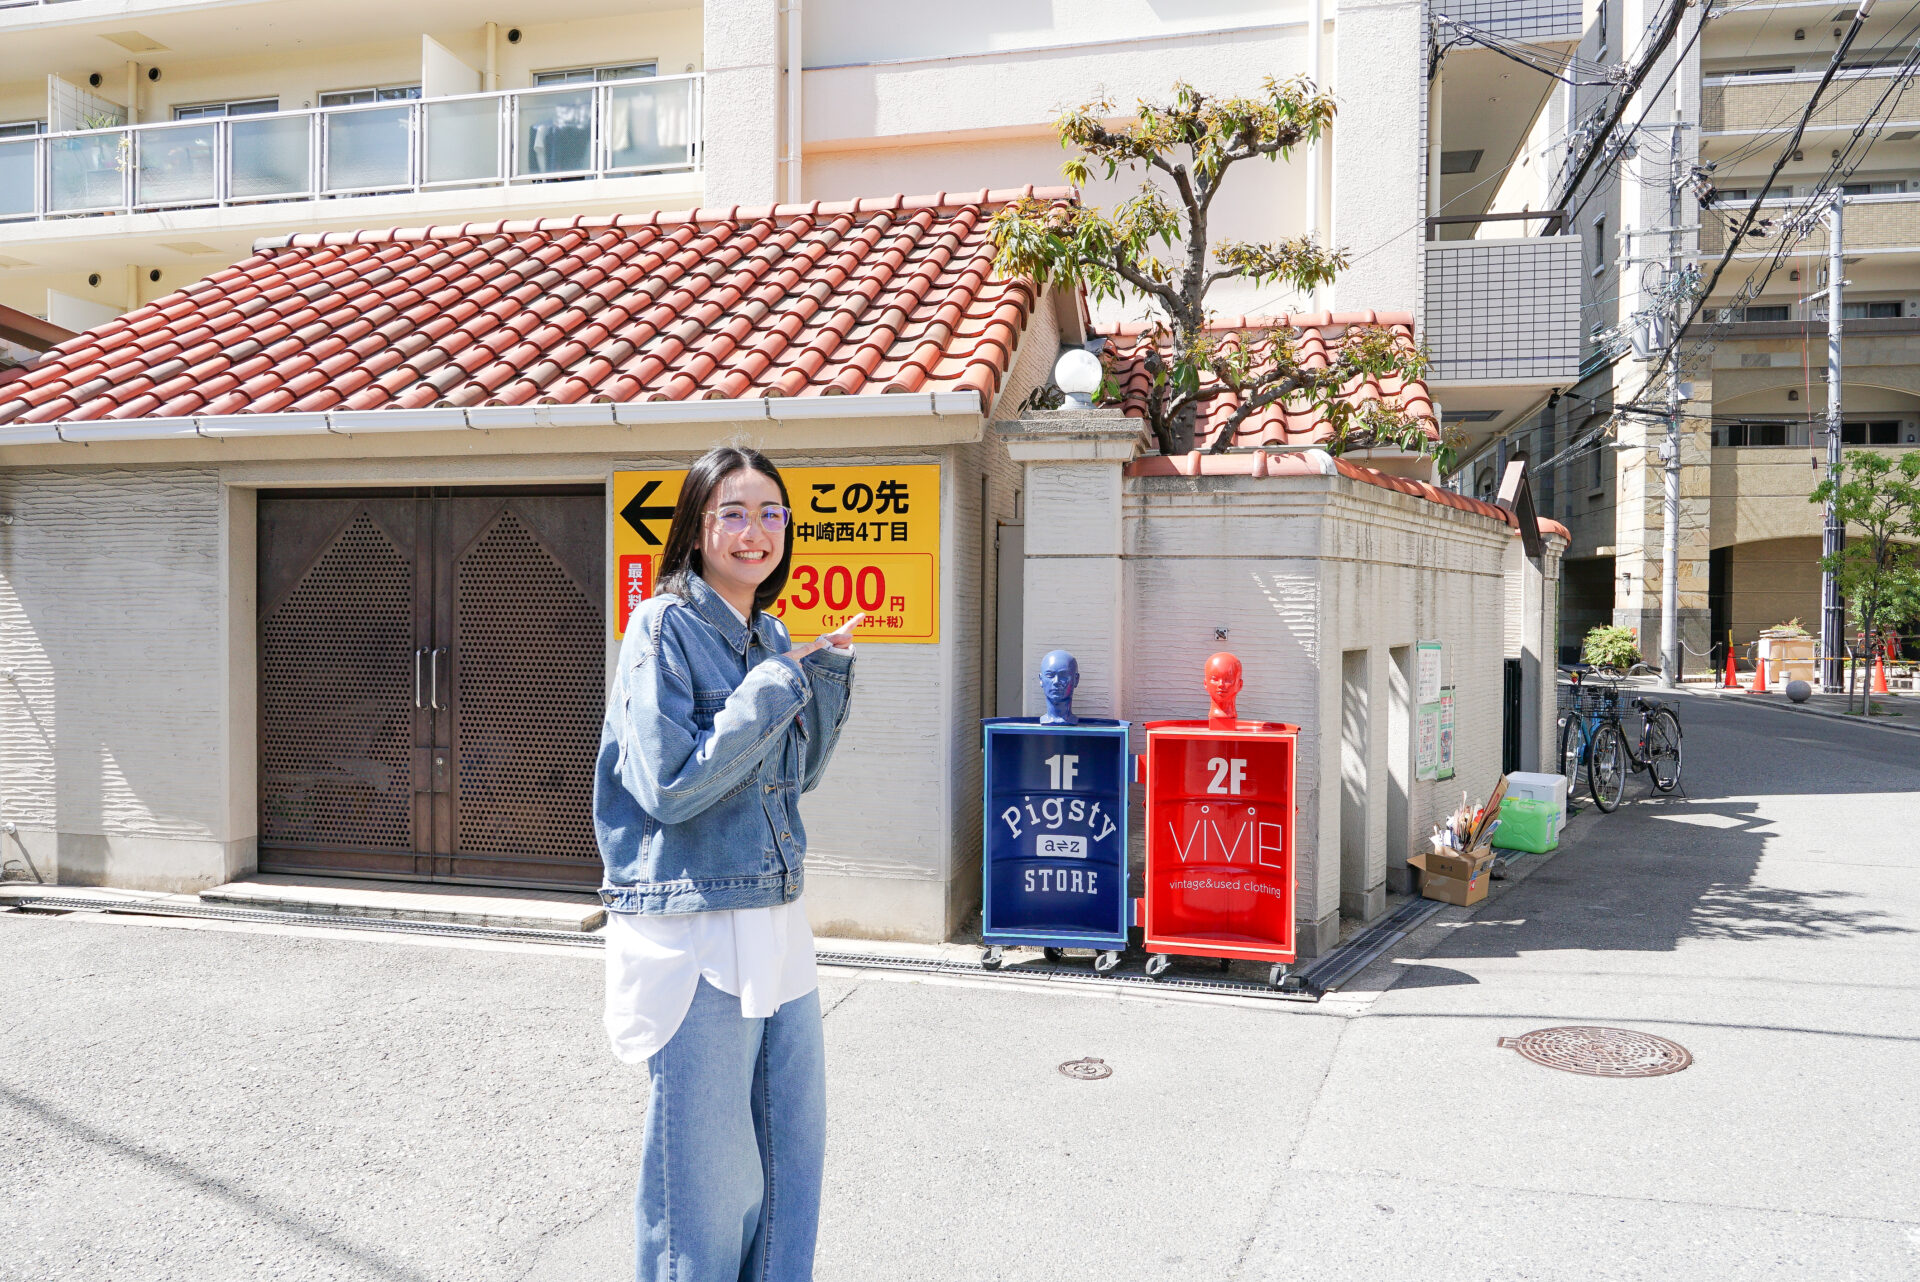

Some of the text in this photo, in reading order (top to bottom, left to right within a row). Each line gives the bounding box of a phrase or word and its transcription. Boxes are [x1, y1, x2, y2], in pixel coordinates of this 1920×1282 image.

[811, 480, 909, 514] この先
[793, 522, 908, 542] 中崎西4丁目
[628, 563, 643, 617] 最大料
[1045, 754, 1079, 790] 1F
[1207, 757, 1247, 795] 2F
[1001, 795, 1117, 842] Pigsty
[1024, 869, 1098, 894] STORE
[1169, 878, 1281, 899] vintage&used clothing
